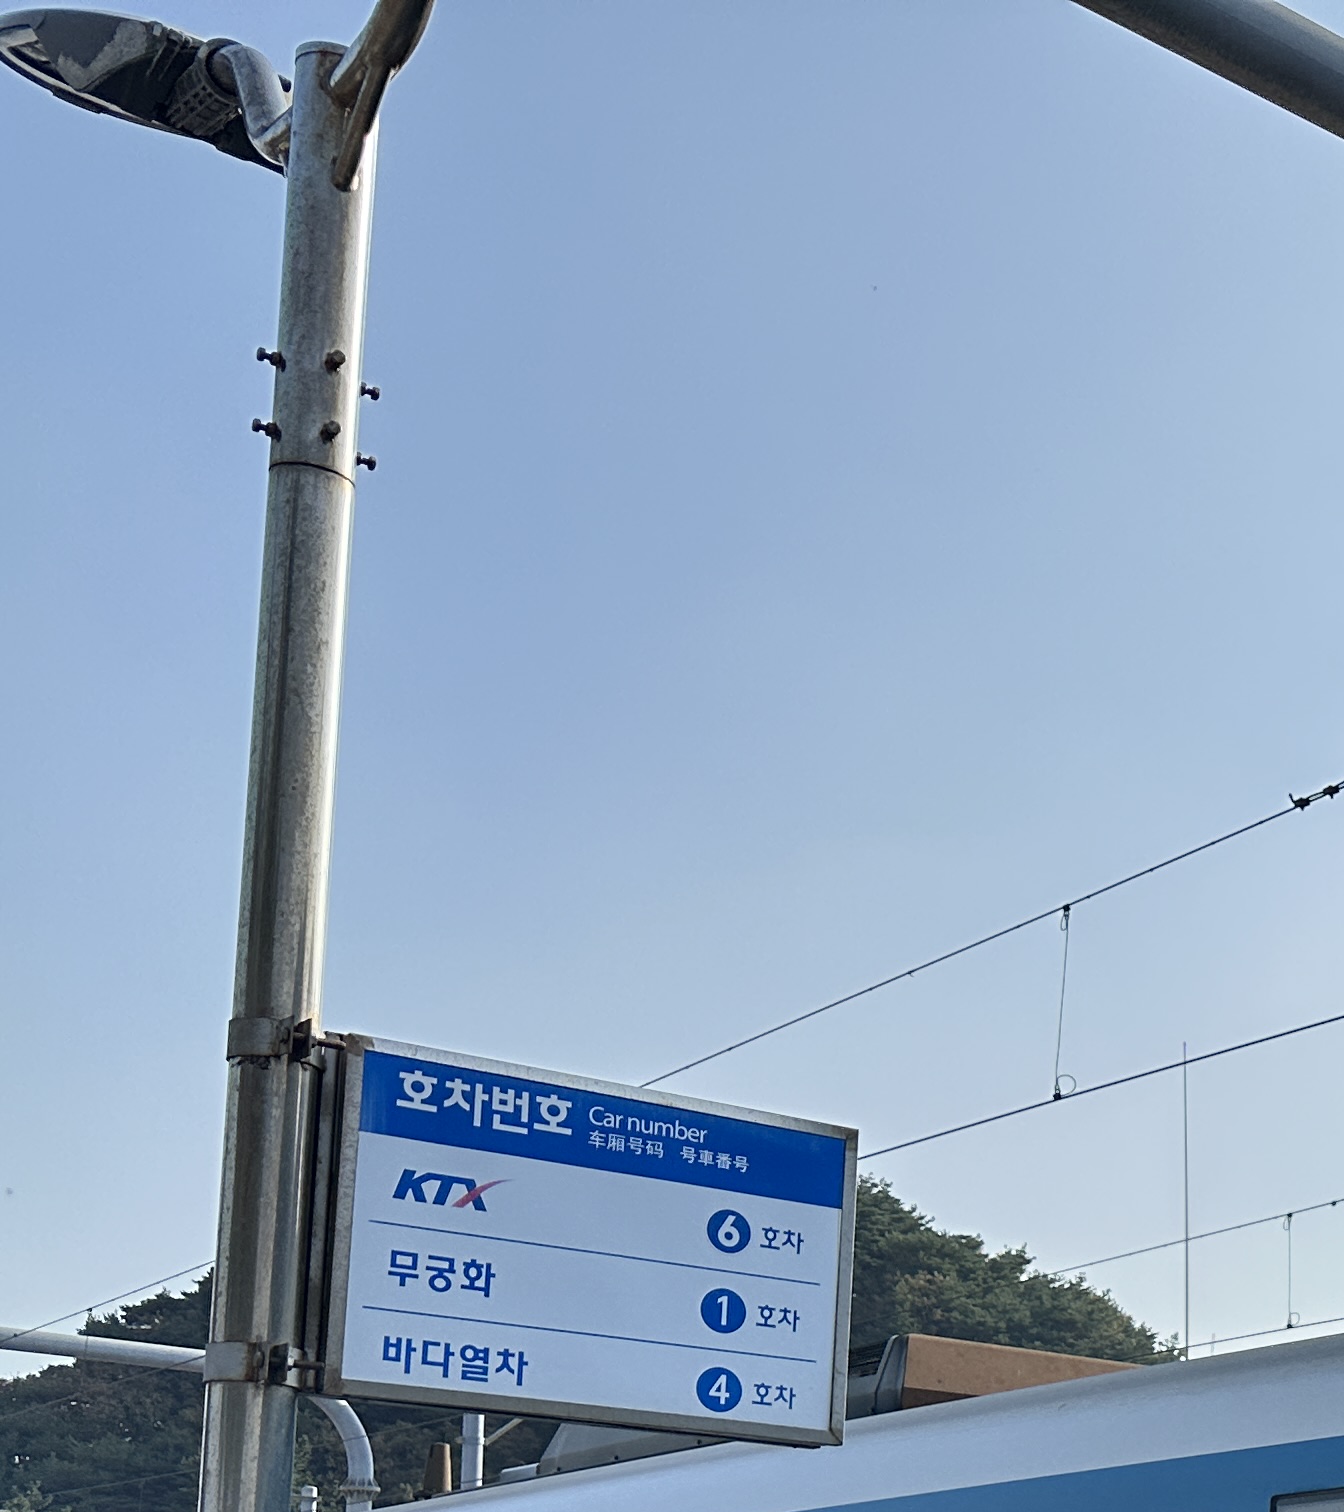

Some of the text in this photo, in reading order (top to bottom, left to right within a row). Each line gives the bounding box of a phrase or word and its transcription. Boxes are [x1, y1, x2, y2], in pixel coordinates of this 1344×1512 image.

[396, 1069, 573, 1136] 호차번호
[588, 1106, 708, 1144] Car number
[588, 1129, 664, 1159] 车厢号码
[392, 1168, 507, 1212] KTX
[717, 1214, 804, 1255] 6 호차
[387, 1249, 496, 1298] 무궁화
[755, 1304, 800, 1332] 호차
[382, 1335, 529, 1387] 바다열차
[708, 1373, 796, 1410] 4 호차
